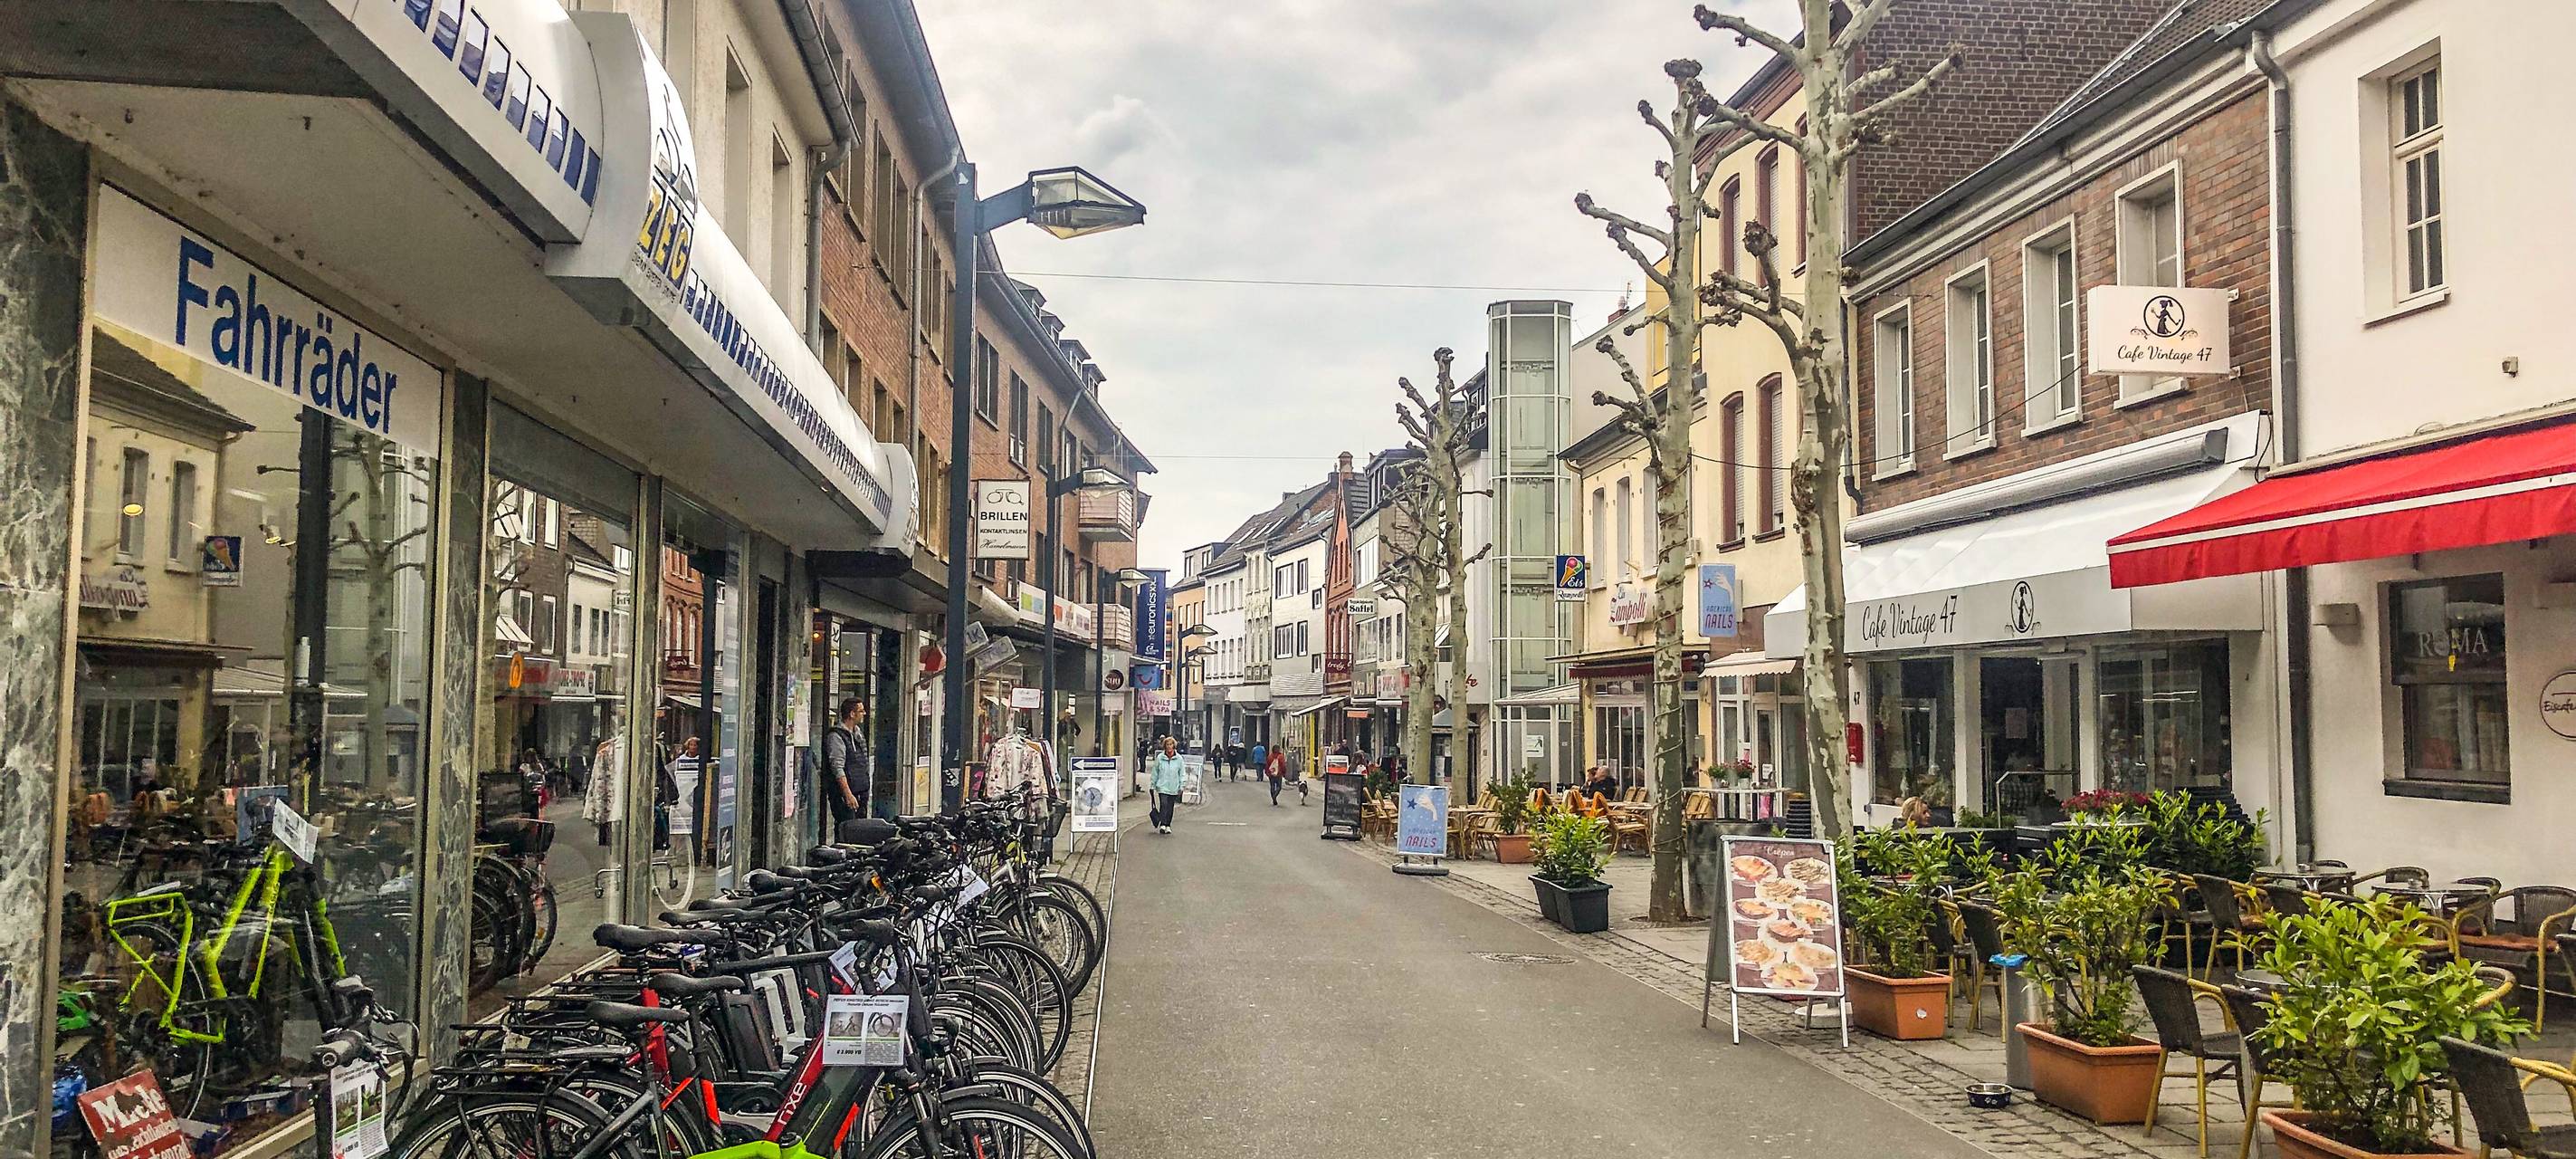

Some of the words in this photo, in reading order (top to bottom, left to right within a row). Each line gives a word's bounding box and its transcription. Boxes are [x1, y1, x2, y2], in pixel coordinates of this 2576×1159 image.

[638, 185, 691, 283] ZEG
[176, 235, 397, 435] Fahrräder
[2117, 344, 2144, 363] Cafe
[2147, 346, 2193, 364] Vintage
[2196, 347, 2213, 362] 47
[980, 512, 1027, 521] BRILLEN
[1567, 576, 1583, 588] Eis
[1705, 614, 1733, 628] NAILS
[1862, 605, 1887, 647] Cafe
[1890, 602, 1936, 644] Vintage
[1940, 595, 1958, 634] 47
[2418, 627, 2488, 657] ROMA
[1854, 691, 1861, 705] 47
[1406, 836, 1437, 848] NAILS
[1764, 845, 1795, 857] Crêpes
